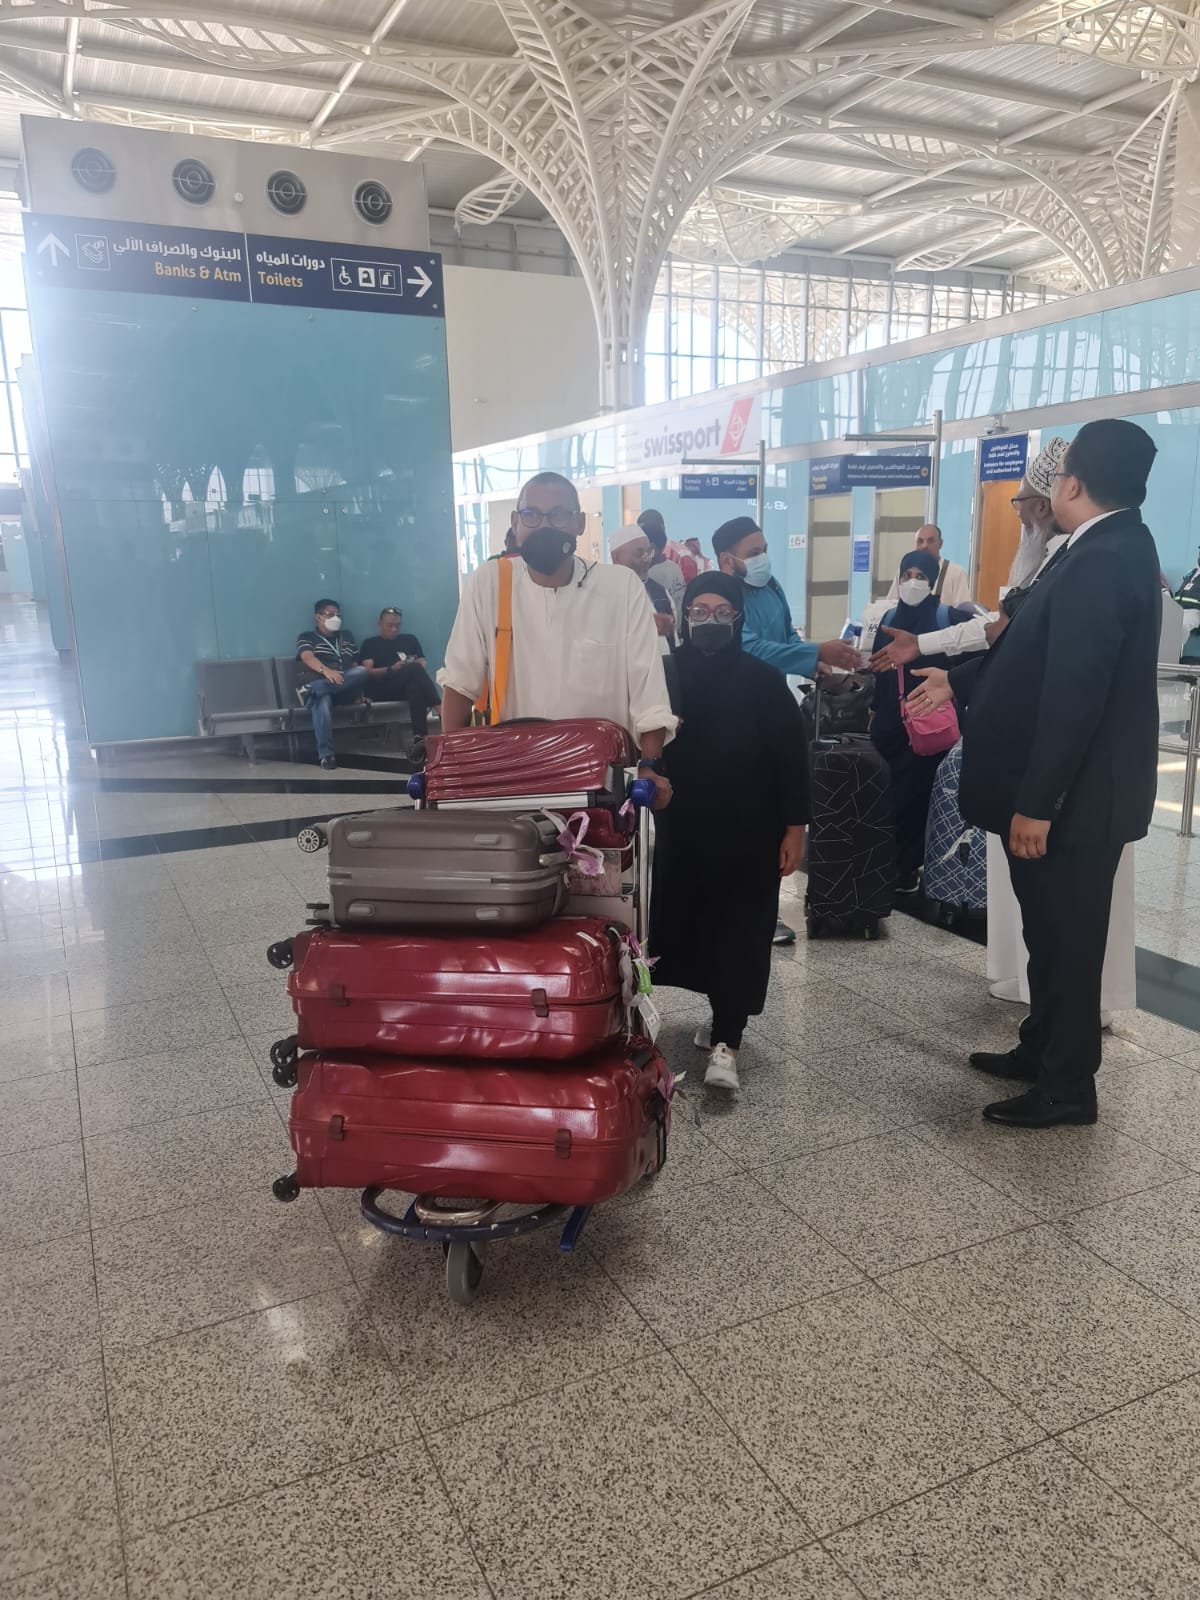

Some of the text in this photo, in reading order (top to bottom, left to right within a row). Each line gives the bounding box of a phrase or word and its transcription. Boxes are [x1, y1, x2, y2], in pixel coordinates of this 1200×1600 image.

[146, 241, 198, 259] والصراف
[200, 246, 241, 262] البنوك
[256, 251, 326, 271] دورات المياه
[155, 262, 242, 282] Banks & Atm
[257, 271, 304, 288] Toilets
[644, 418, 721, 460] swissport
